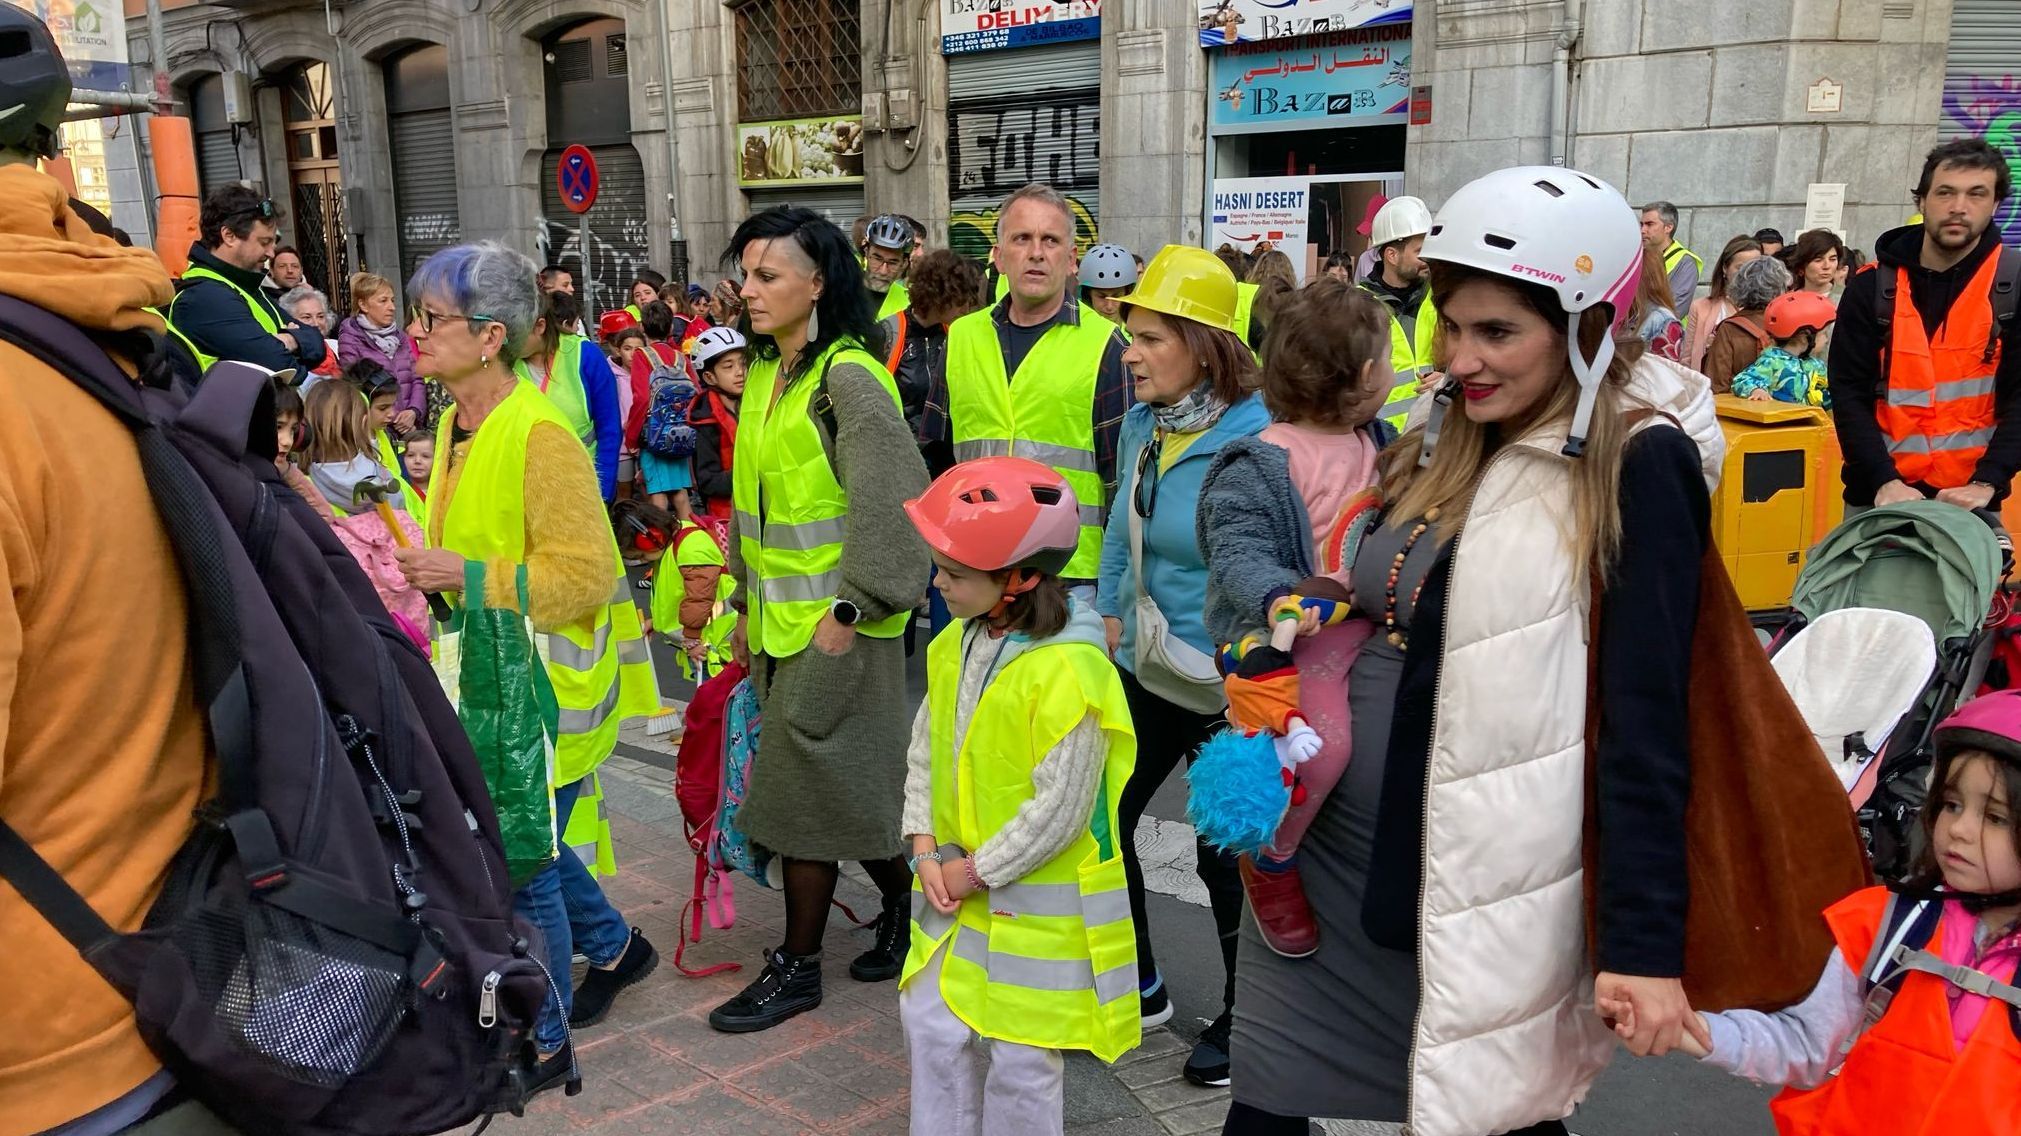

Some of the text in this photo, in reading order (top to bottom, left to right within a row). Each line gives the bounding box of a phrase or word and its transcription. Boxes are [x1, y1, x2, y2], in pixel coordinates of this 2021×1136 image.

[977, 0, 1102, 30] DELIVERY
[1215, 191, 1305, 210] HASNI DESERT
